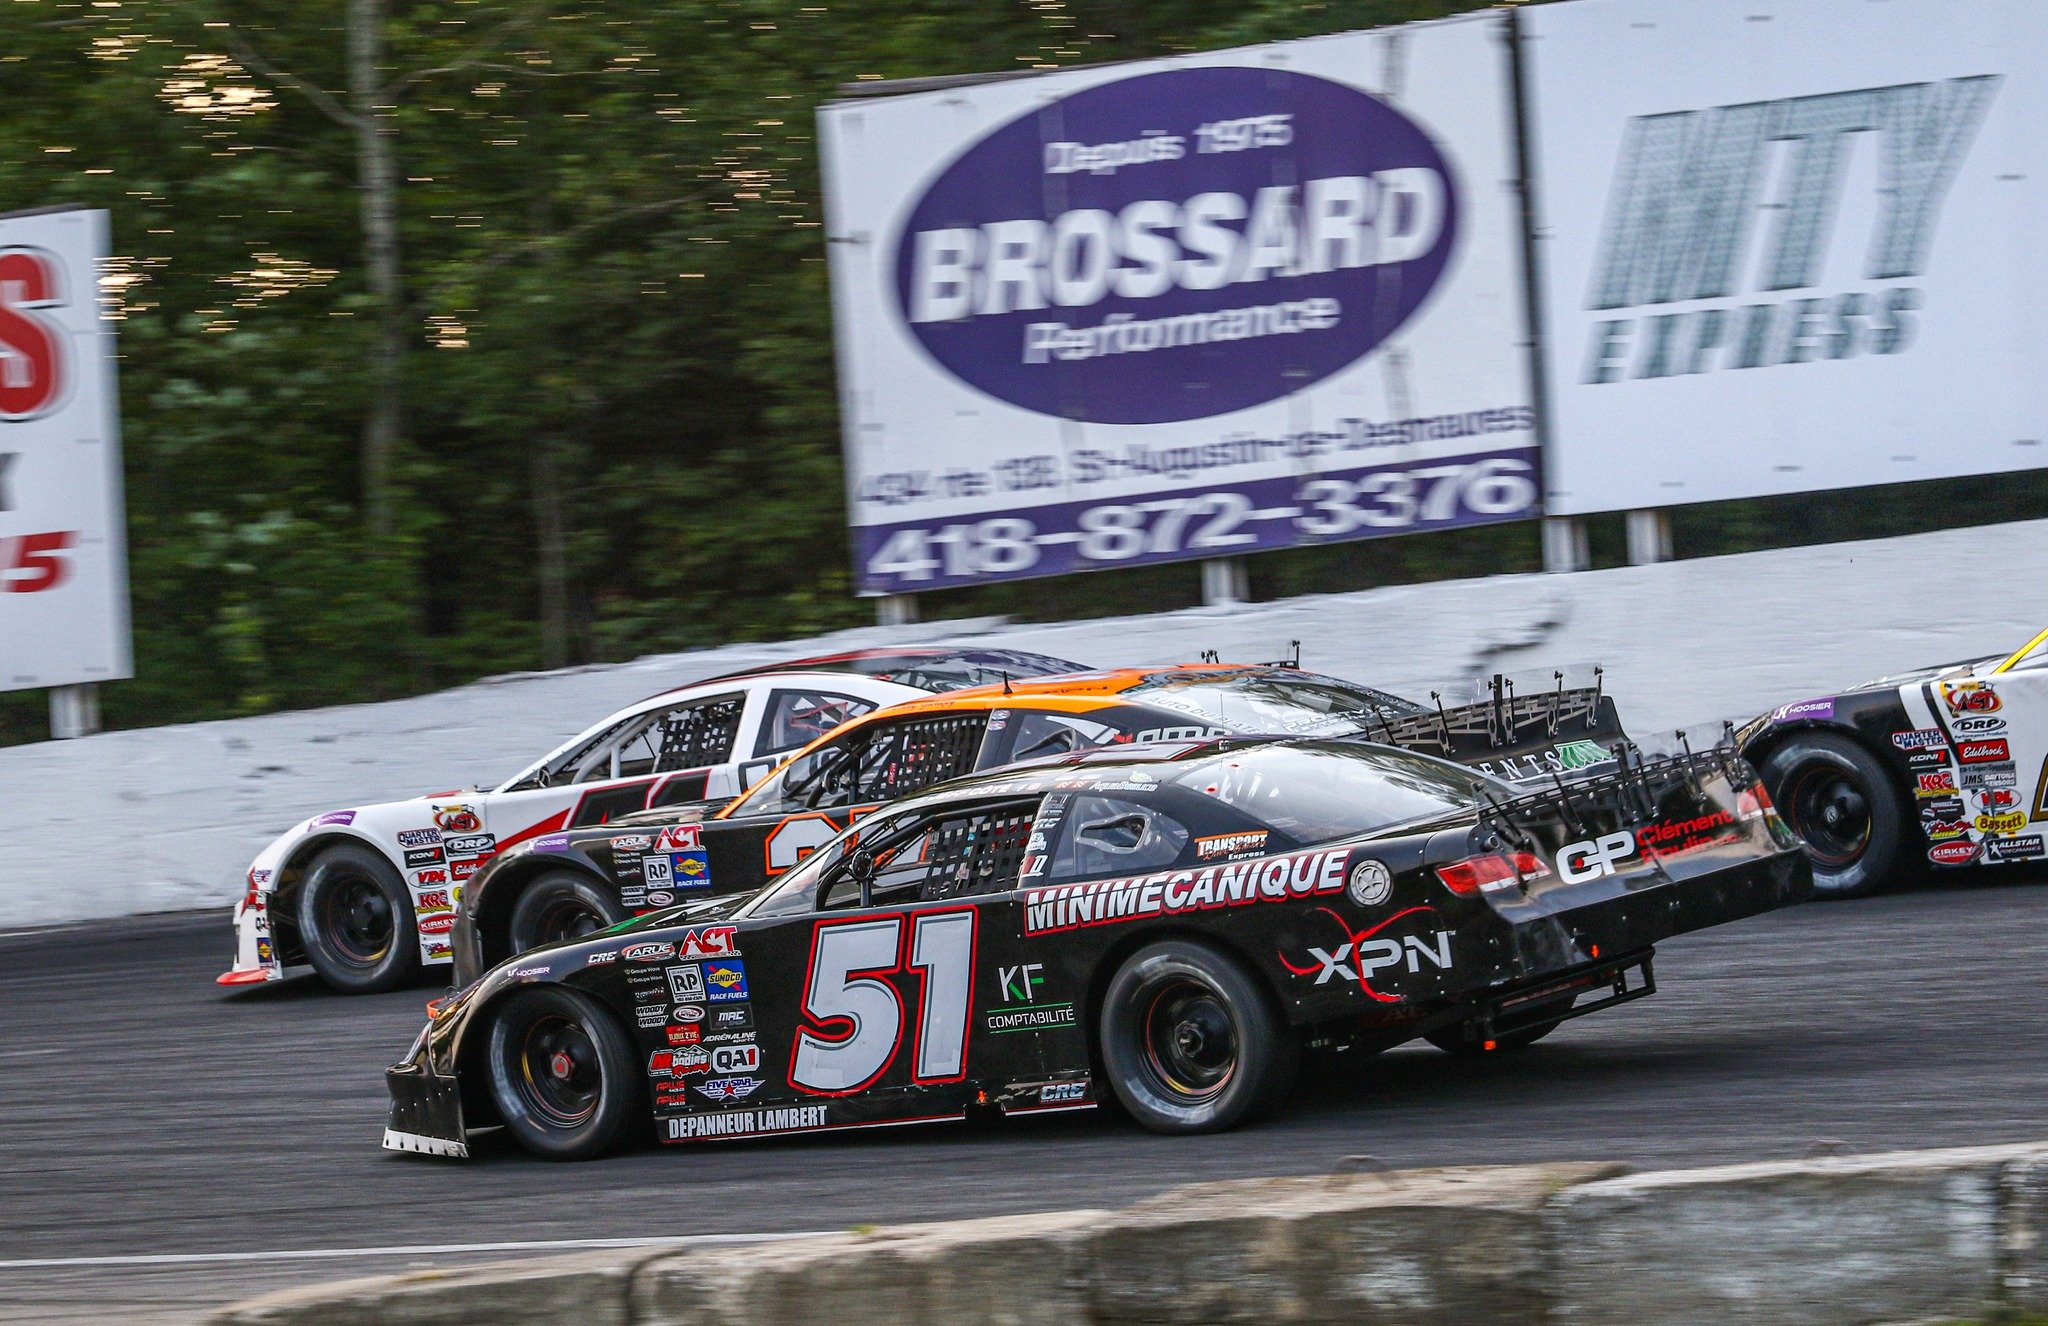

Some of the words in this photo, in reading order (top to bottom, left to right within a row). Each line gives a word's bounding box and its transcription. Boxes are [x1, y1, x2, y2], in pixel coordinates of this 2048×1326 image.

[1045, 129, 1185, 175] Depuis
[908, 166, 1448, 323] BROSSARD
[1022, 296, 1342, 364] Performance
[1578, 286, 1926, 384] EXPRESS
[868, 459, 1537, 580] 418-872-3376
[1789, 701, 1832, 714] HOOSIER
[1960, 719, 1998, 731] DRP
[1893, 730, 1940, 744] QUARTER
[1904, 738, 1943, 748] MASTER
[1909, 753, 1938, 762] KONI
[1963, 743, 2004, 758] Edelbrock
[1919, 771, 1953, 791] KRC
[1964, 774, 1983, 786] JMS
[1634, 808, 1736, 847] Clément
[1979, 813, 2022, 831] Bassett
[453, 838, 488, 849] DRP
[653, 823, 704, 850] ACT
[1998, 838, 2040, 849] ALLSTAR
[1228, 849, 1266, 861] Express
[1933, 846, 1974, 857] KIRKEY
[648, 863, 668, 879] RP
[679, 925, 739, 956] ACT
[625, 943, 673, 960] LARUE
[1307, 930, 1452, 985] XPN
[516, 966, 551, 977] HOOSIER
[672, 973, 698, 992] RP
[708, 973, 742, 984] SUNOCO
[997, 963, 1044, 1002] KF
[710, 993, 726, 1001] RACE
[727, 991, 748, 999] FUELS
[788, 905, 979, 1097] 51
[637, 1005, 666, 1015] WOODY
[718, 1010, 745, 1021] MAC
[987, 1005, 1075, 1030] COMPTABILITÉ
[639, 1015, 668, 1025] WOODY
[716, 1048, 756, 1071] QA1
[705, 1081, 729, 1091] FIVE
[730, 1077, 754, 1088] STAR
[668, 1112, 754, 1139] DEPANNEUR
[758, 1105, 828, 1131] LAMBERT
